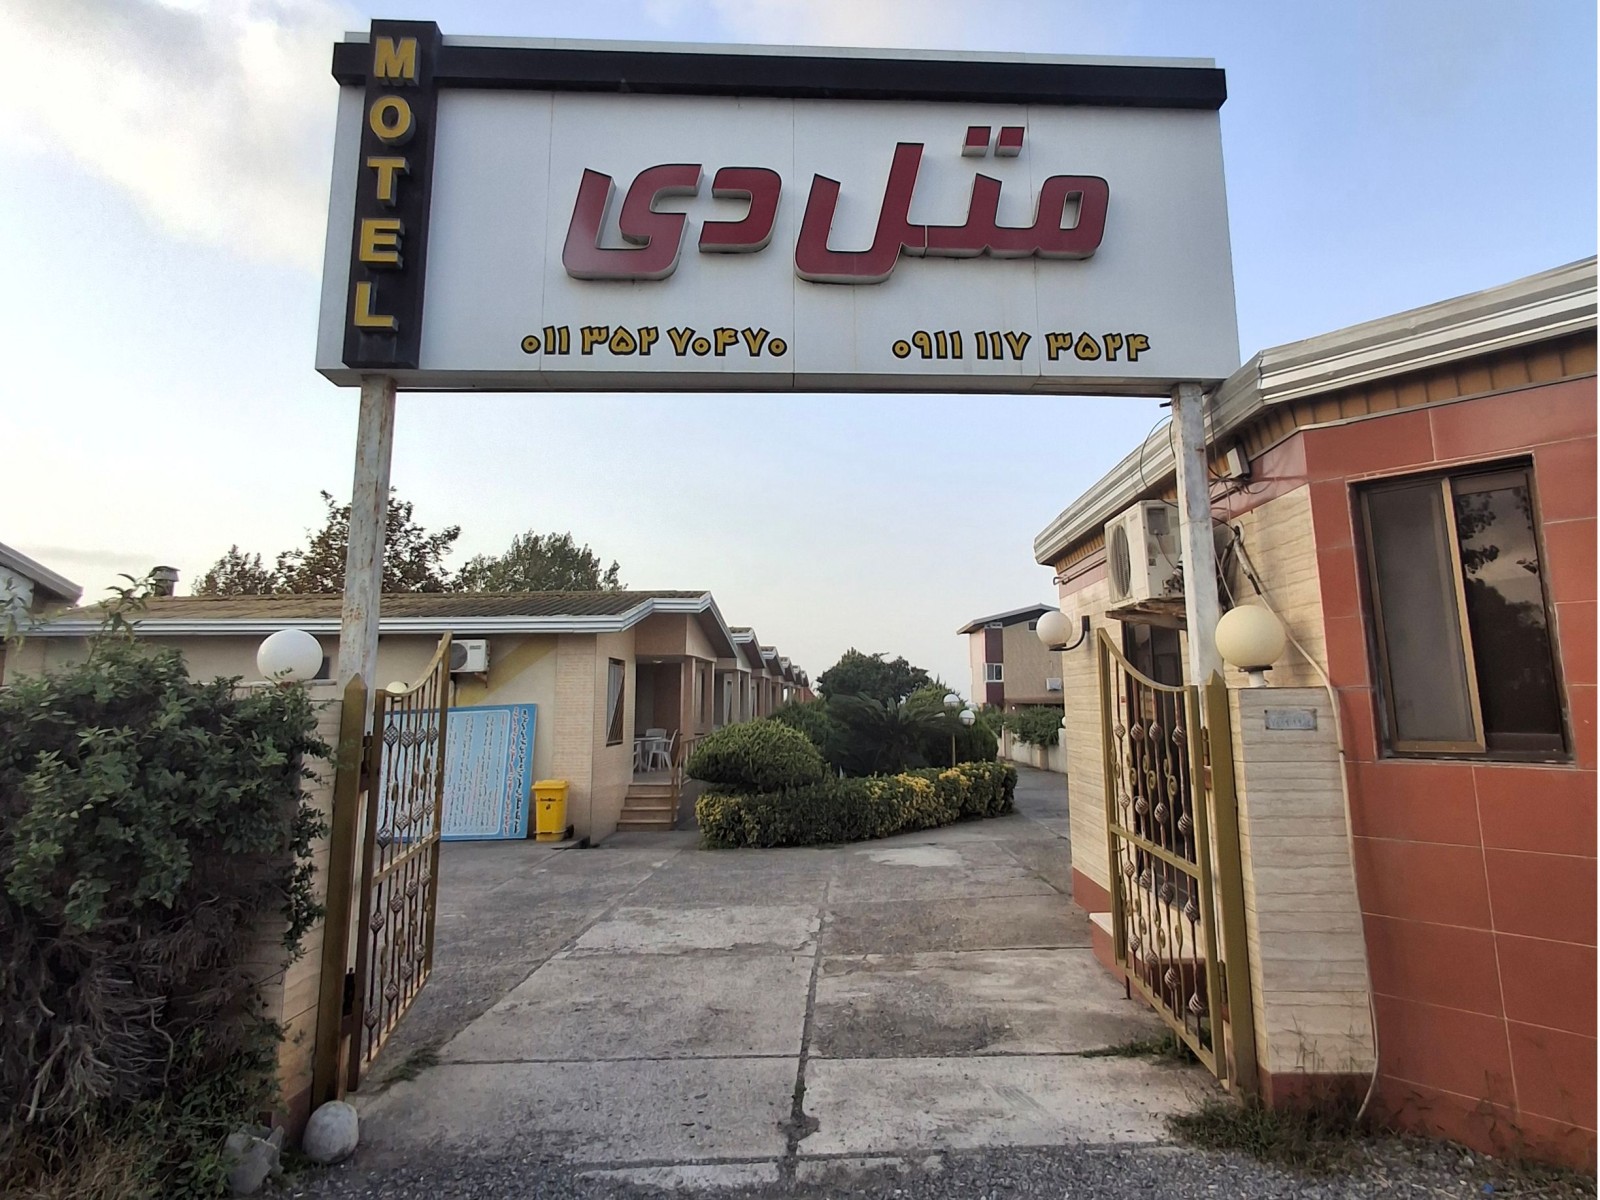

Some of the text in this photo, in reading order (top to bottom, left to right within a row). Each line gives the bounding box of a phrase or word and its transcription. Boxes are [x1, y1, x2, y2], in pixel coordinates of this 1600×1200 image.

[353, 36, 418, 333] MOTEL
[562, 125, 1110, 284] متل دی
[521, 325, 788, 358] ۰۱۱ ۳۵۲ ۷۰۴۷۰
[892, 330, 1151, 362] ۰۹۱۱ ۱۱۷ ۳۵۲۴
